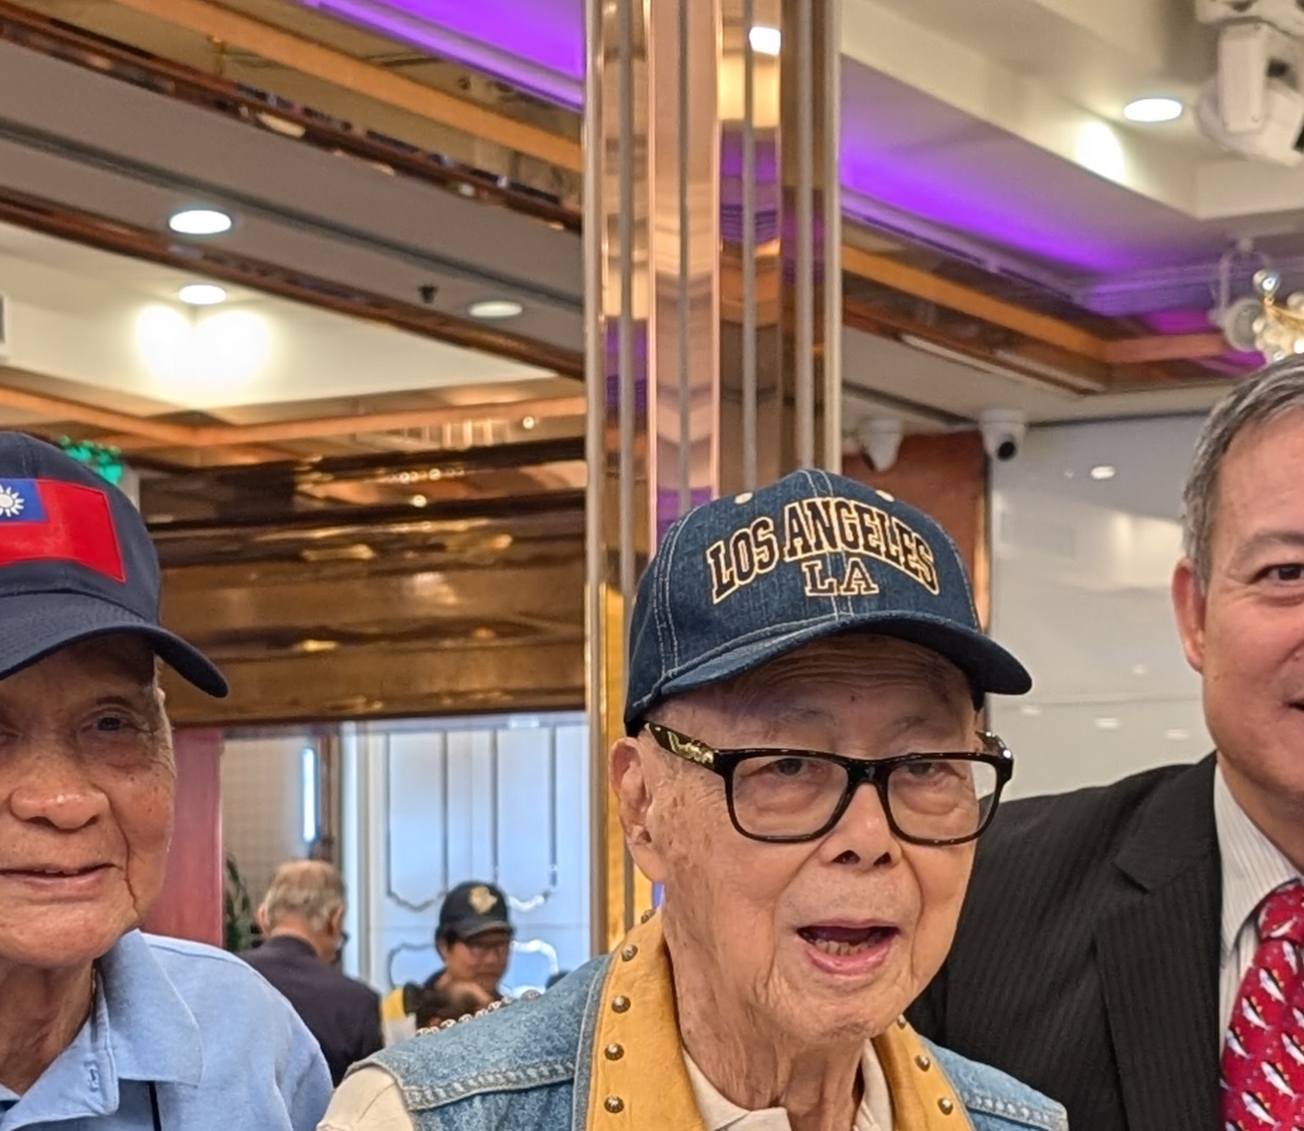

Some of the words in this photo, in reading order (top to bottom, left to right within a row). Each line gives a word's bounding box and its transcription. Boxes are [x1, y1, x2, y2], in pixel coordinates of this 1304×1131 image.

[705, 515, 779, 605] LOS
[783, 497, 940, 596] ANGELES
[801, 557, 880, 597] LA
